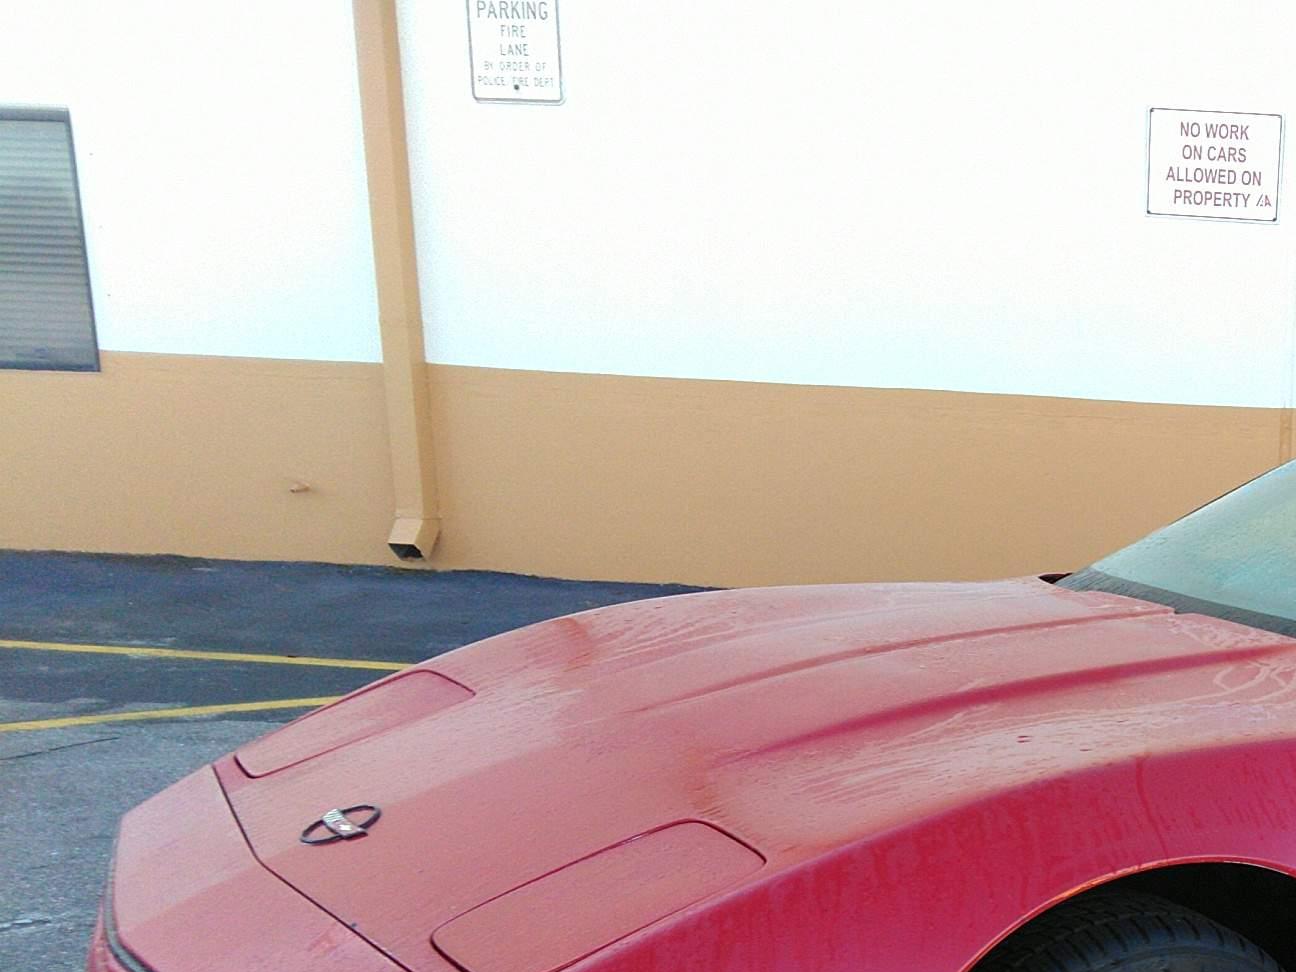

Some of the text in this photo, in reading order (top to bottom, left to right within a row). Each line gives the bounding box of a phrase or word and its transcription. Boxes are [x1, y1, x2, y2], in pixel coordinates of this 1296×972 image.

[476, 0, 548, 20] PARKING
[500, 25, 527, 38] FIRE
[500, 44, 529, 56] LANE
[483, 60, 547, 72] BY ORDER OF
[1180, 121, 1250, 140] NO WORK
[1182, 144, 1247, 163] ON CARS
[1165, 166, 1262, 186] ALLOWED ON
[1173, 189, 1251, 208] PROPERTY
